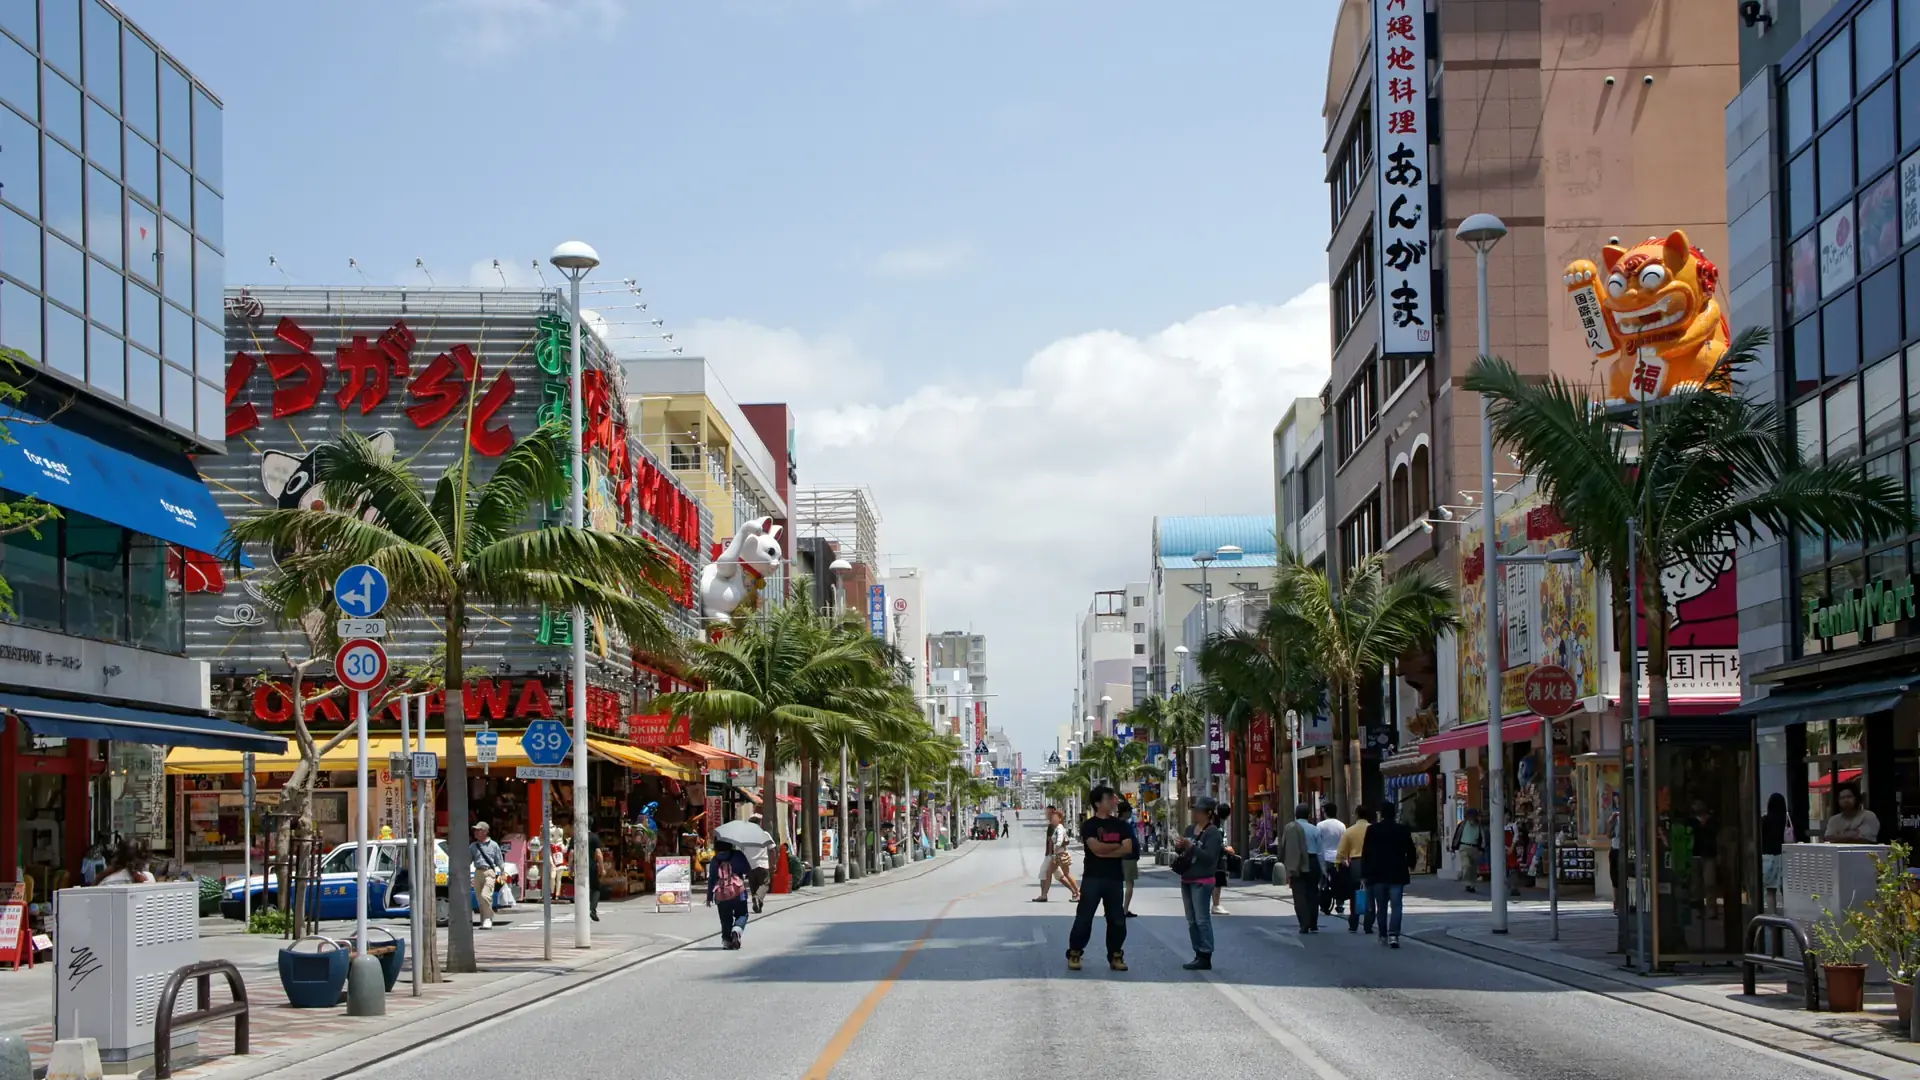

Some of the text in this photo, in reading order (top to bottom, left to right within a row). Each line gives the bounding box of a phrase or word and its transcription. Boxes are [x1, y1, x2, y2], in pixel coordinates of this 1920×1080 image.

[1385, 142, 1428, 328] あんがま
[1574, 293, 1604, 350] 国際通りへ
[1807, 573, 1916, 643] FamilyMart
[347, 653, 376, 676] 30
[1528, 681, 1573, 700] 消火栓
[531, 732, 562, 750] 39
[630, 725, 685, 734] OKINAA
